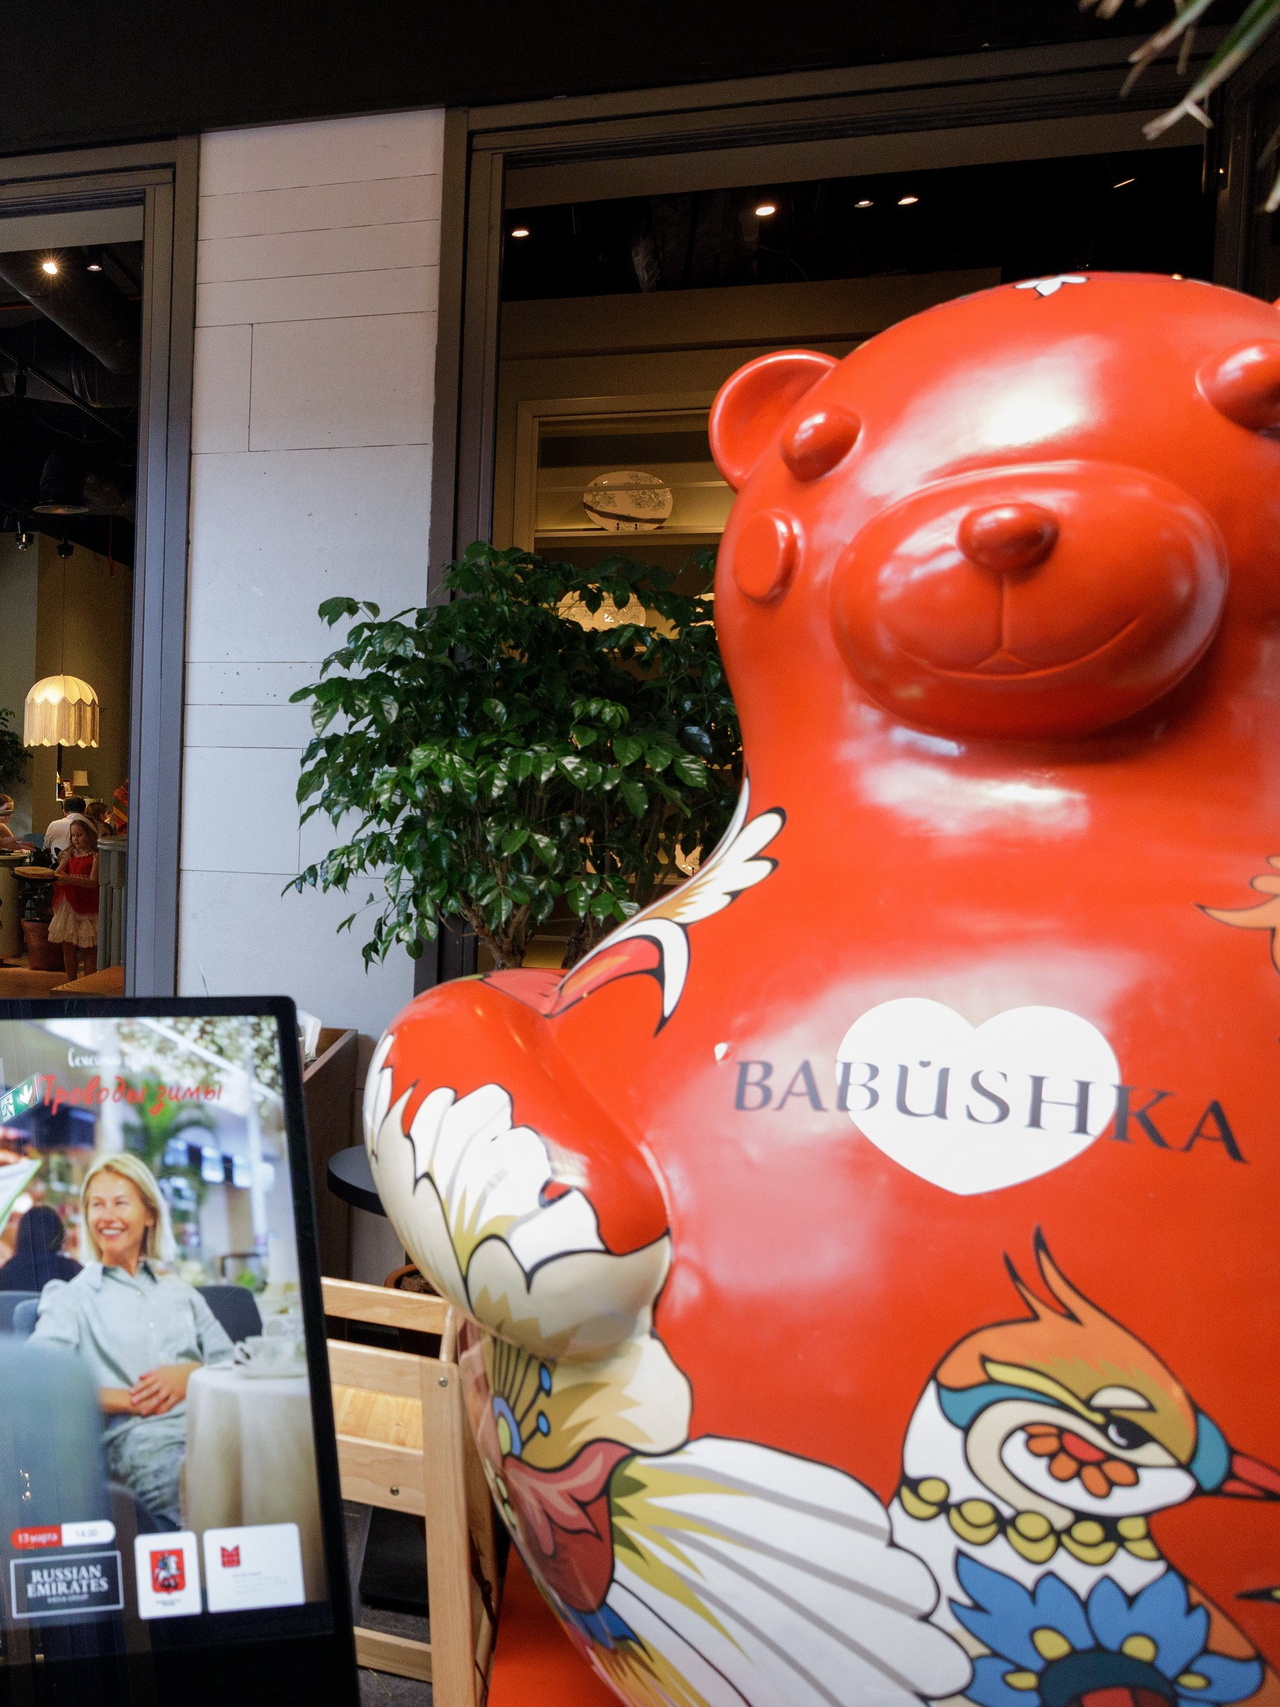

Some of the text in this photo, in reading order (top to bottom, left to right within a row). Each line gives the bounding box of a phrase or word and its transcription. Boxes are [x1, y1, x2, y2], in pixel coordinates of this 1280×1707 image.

[35, 1074, 222, 1117] Проводы зимы
[31, 1564, 102, 1584] RUSSIAN
[27, 1576, 109, 1599] EMIRATES
